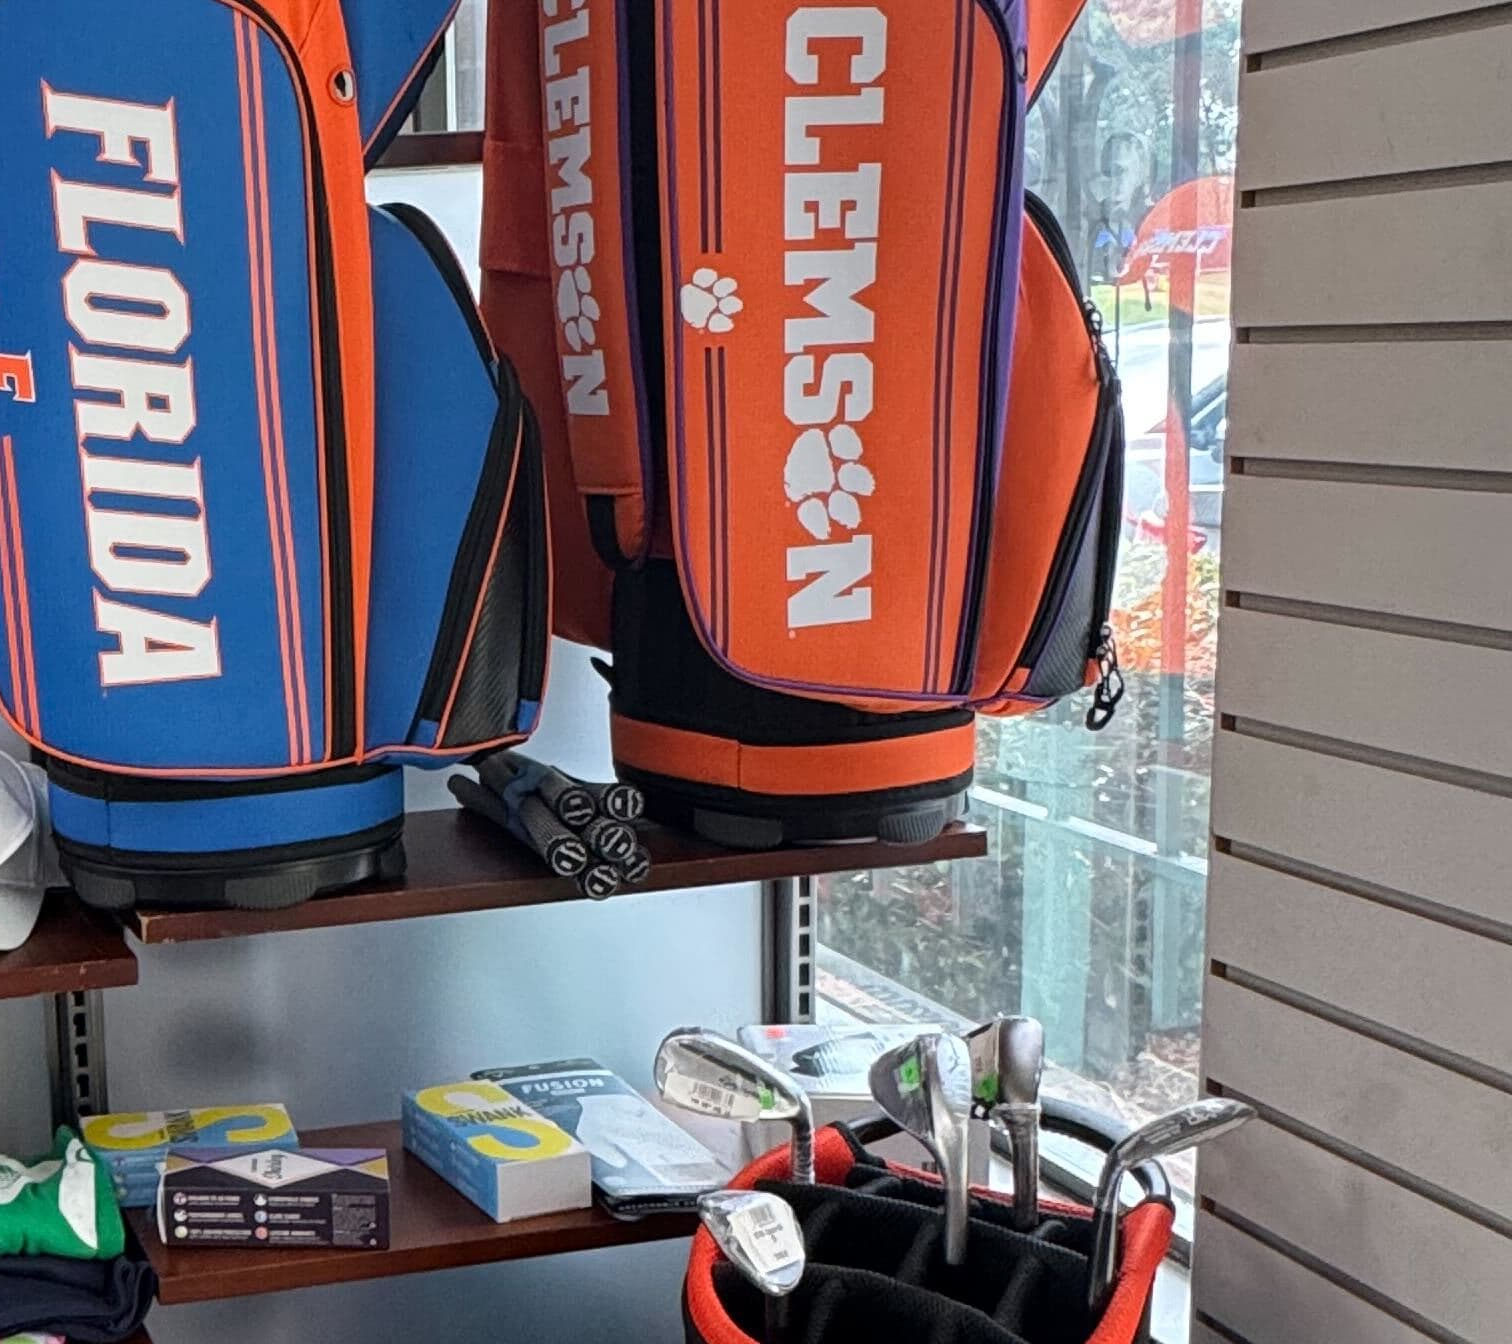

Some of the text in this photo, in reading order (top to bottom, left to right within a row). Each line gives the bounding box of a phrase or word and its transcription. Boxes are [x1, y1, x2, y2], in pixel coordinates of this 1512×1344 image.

[41, 79, 222, 688] FLORIDA
[521, 1078, 605, 1094] FUSION
[447, 1105, 528, 1127] SWANK
